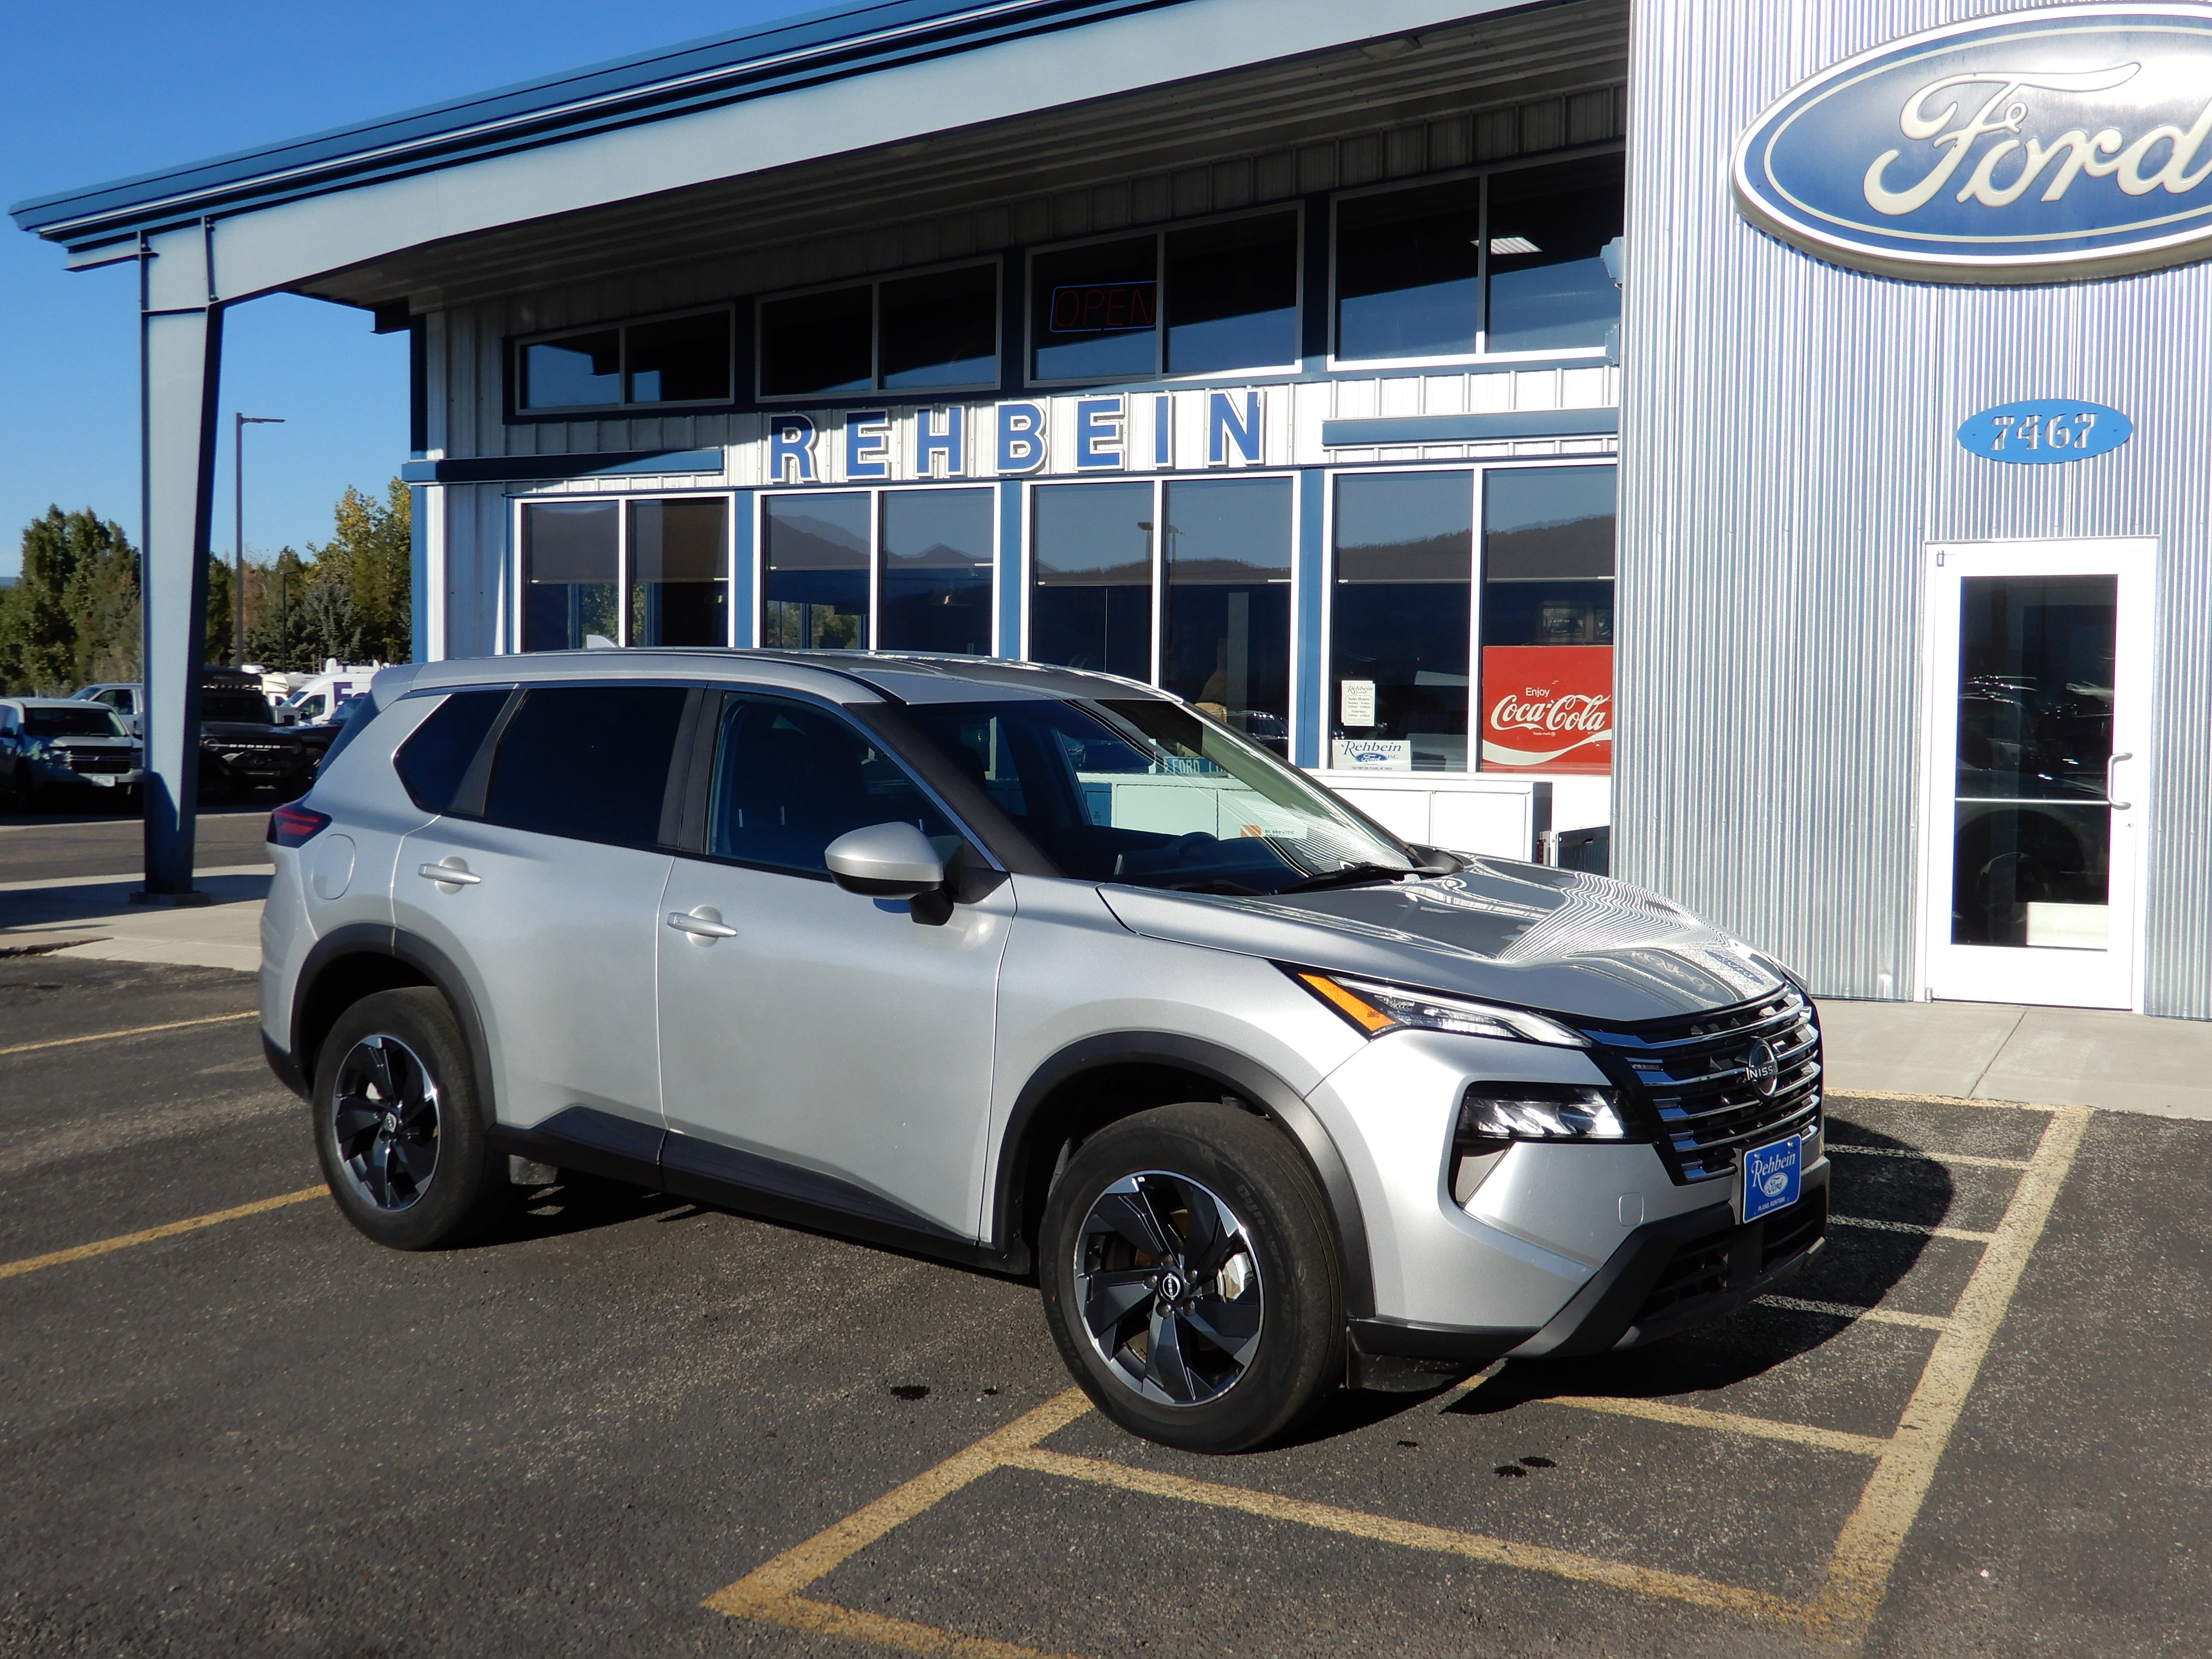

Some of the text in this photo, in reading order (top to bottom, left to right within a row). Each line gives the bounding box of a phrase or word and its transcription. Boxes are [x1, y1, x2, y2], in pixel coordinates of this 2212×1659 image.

[1863, 62, 2212, 216] Ford
[1055, 287, 1157, 327] OPEN
[767, 390, 1267, 484] REHBEIN
[1991, 413, 2098, 451] 7467
[1347, 685, 1373, 695] Rehbein
[1525, 687, 1550, 697] Enjoy
[1491, 695, 1611, 731] Coca-Cola
[1341, 741, 1402, 759] Rehbein
[1361, 754, 1381, 763] Ford
[1749, 1065, 1773, 1078] NISS
[1751, 1151, 1796, 1188] Rehbein
[1765, 1176, 1784, 1193] Ford
